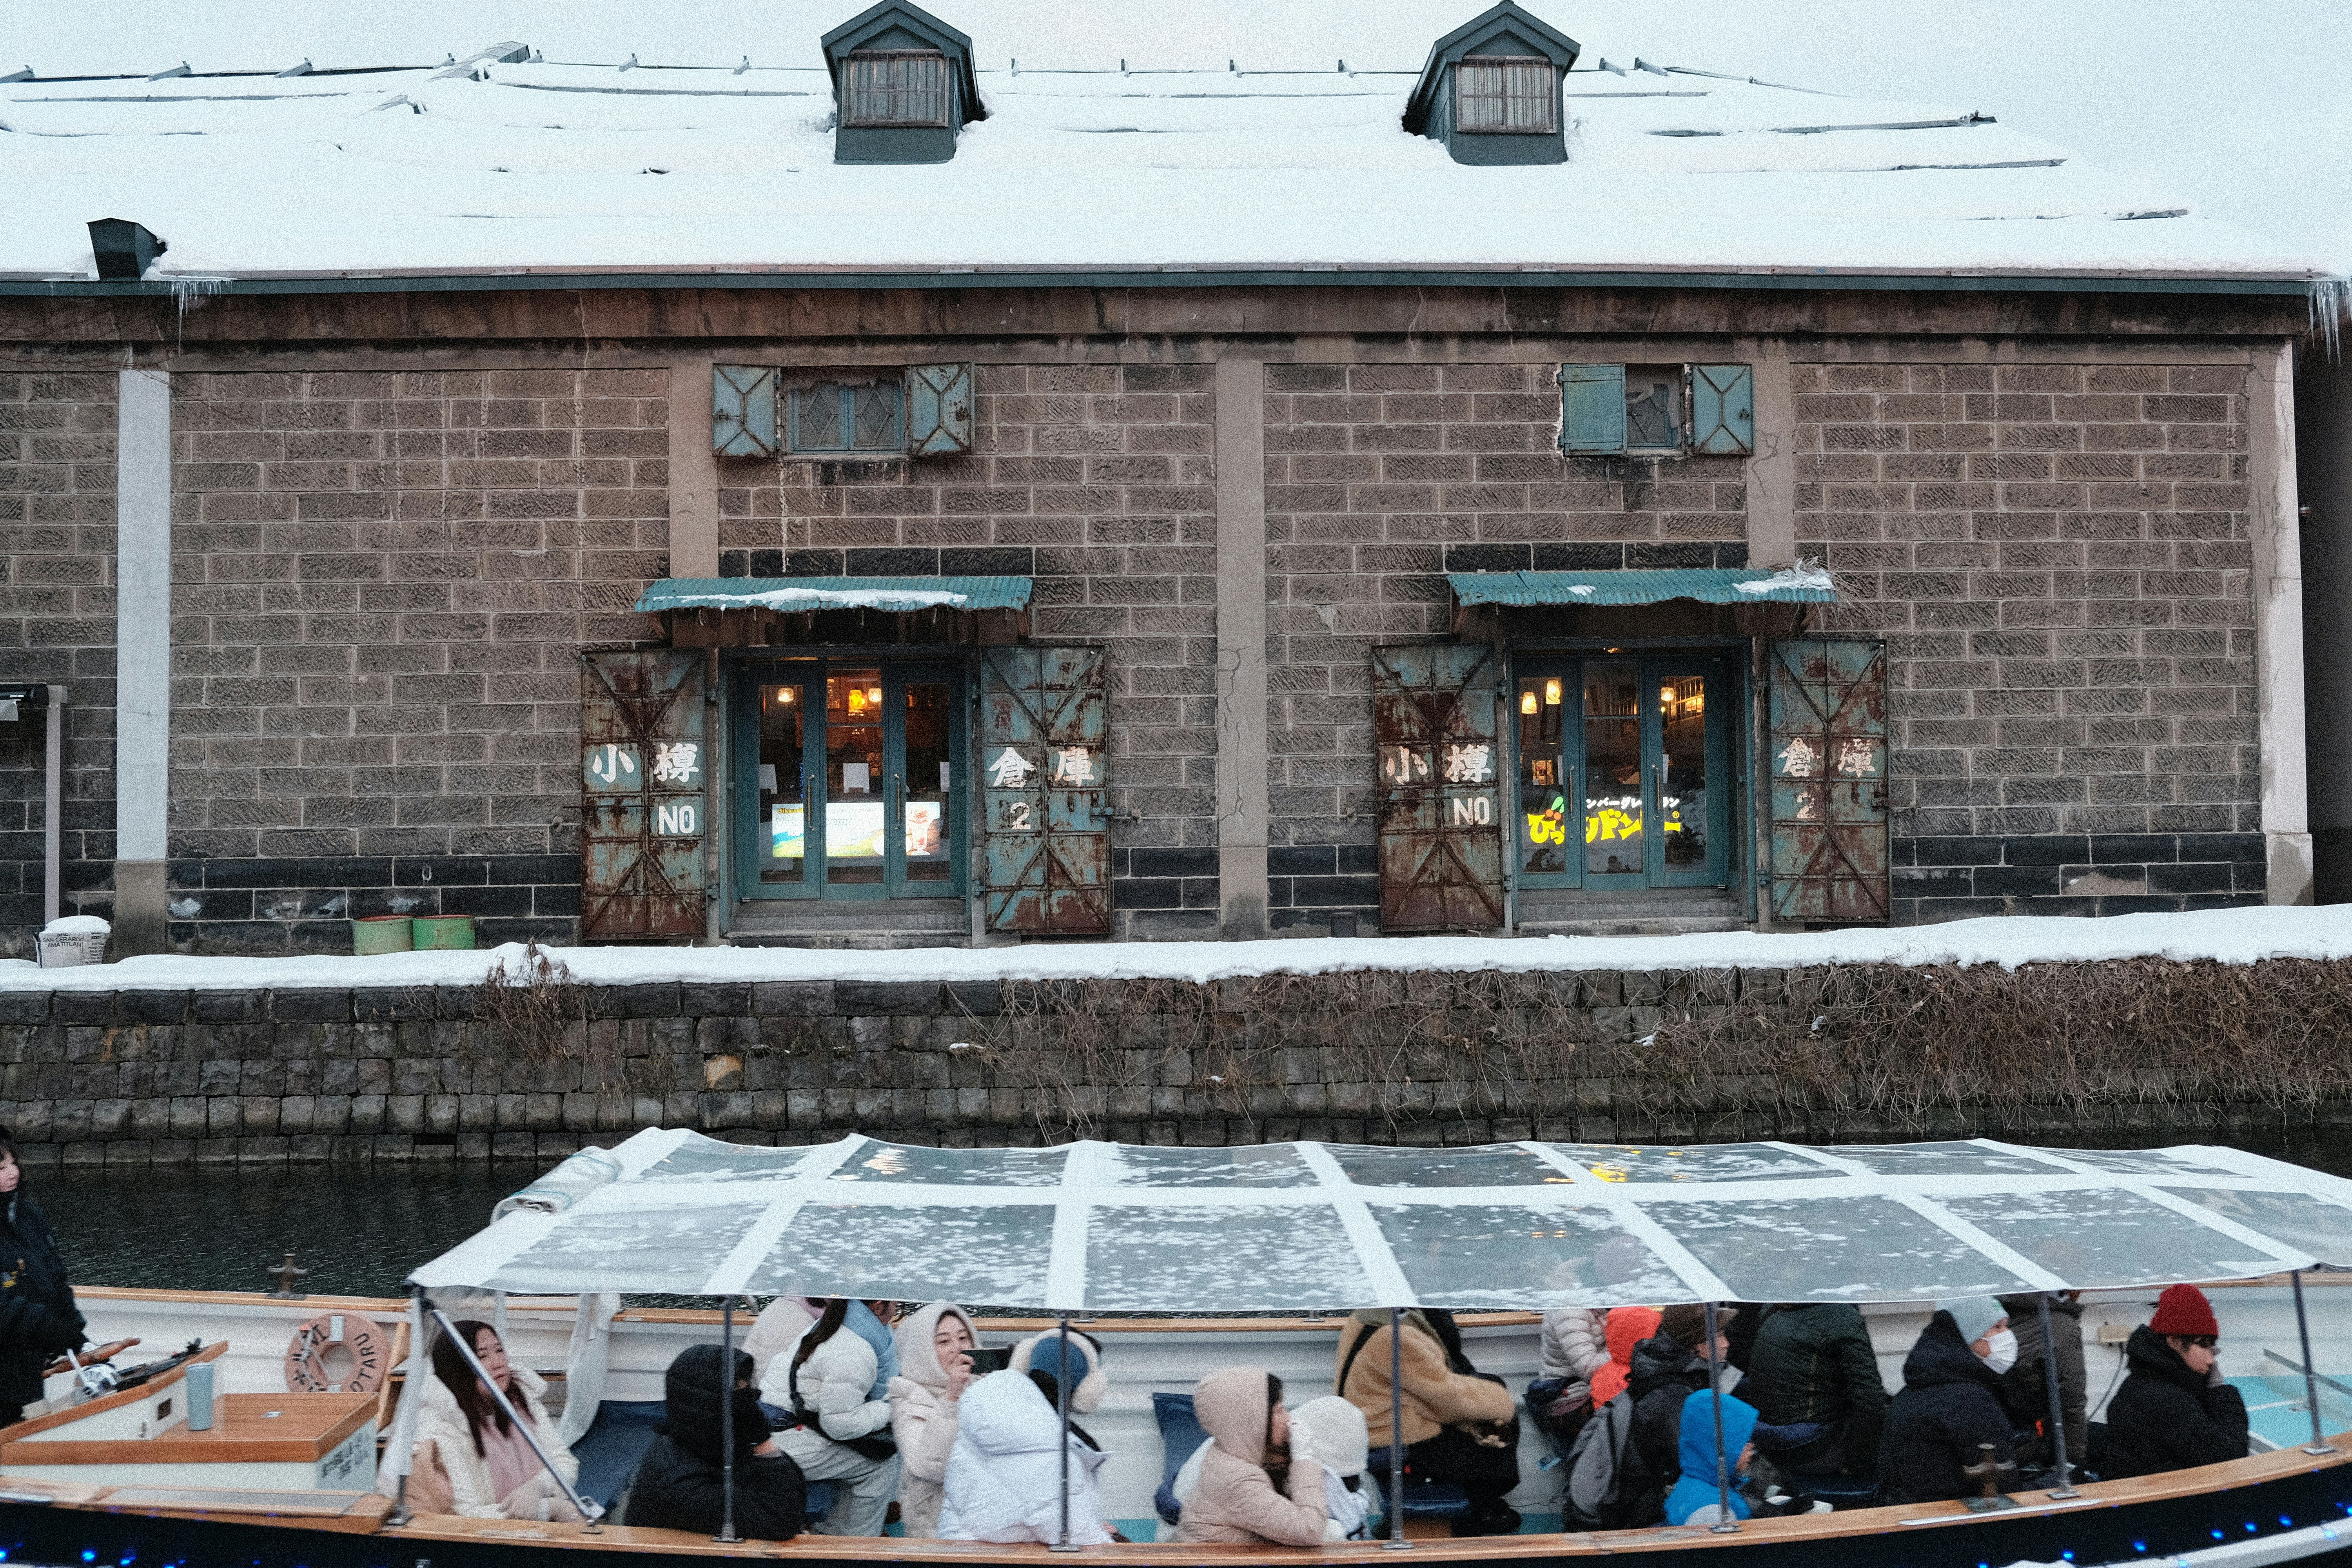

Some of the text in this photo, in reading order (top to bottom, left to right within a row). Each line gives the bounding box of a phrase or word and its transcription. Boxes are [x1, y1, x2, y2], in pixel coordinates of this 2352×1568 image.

[592, 743, 699, 783] 小樽
[989, 746, 1094, 788] 倉庫
[1386, 744, 1491, 784] 小樽
[659, 805, 695, 834] NO
[1010, 802, 1031, 829] 2
[1453, 797, 1489, 825] NO
[1797, 792, 1816, 818] 2
[350, 1333, 376, 1392] OTARU
